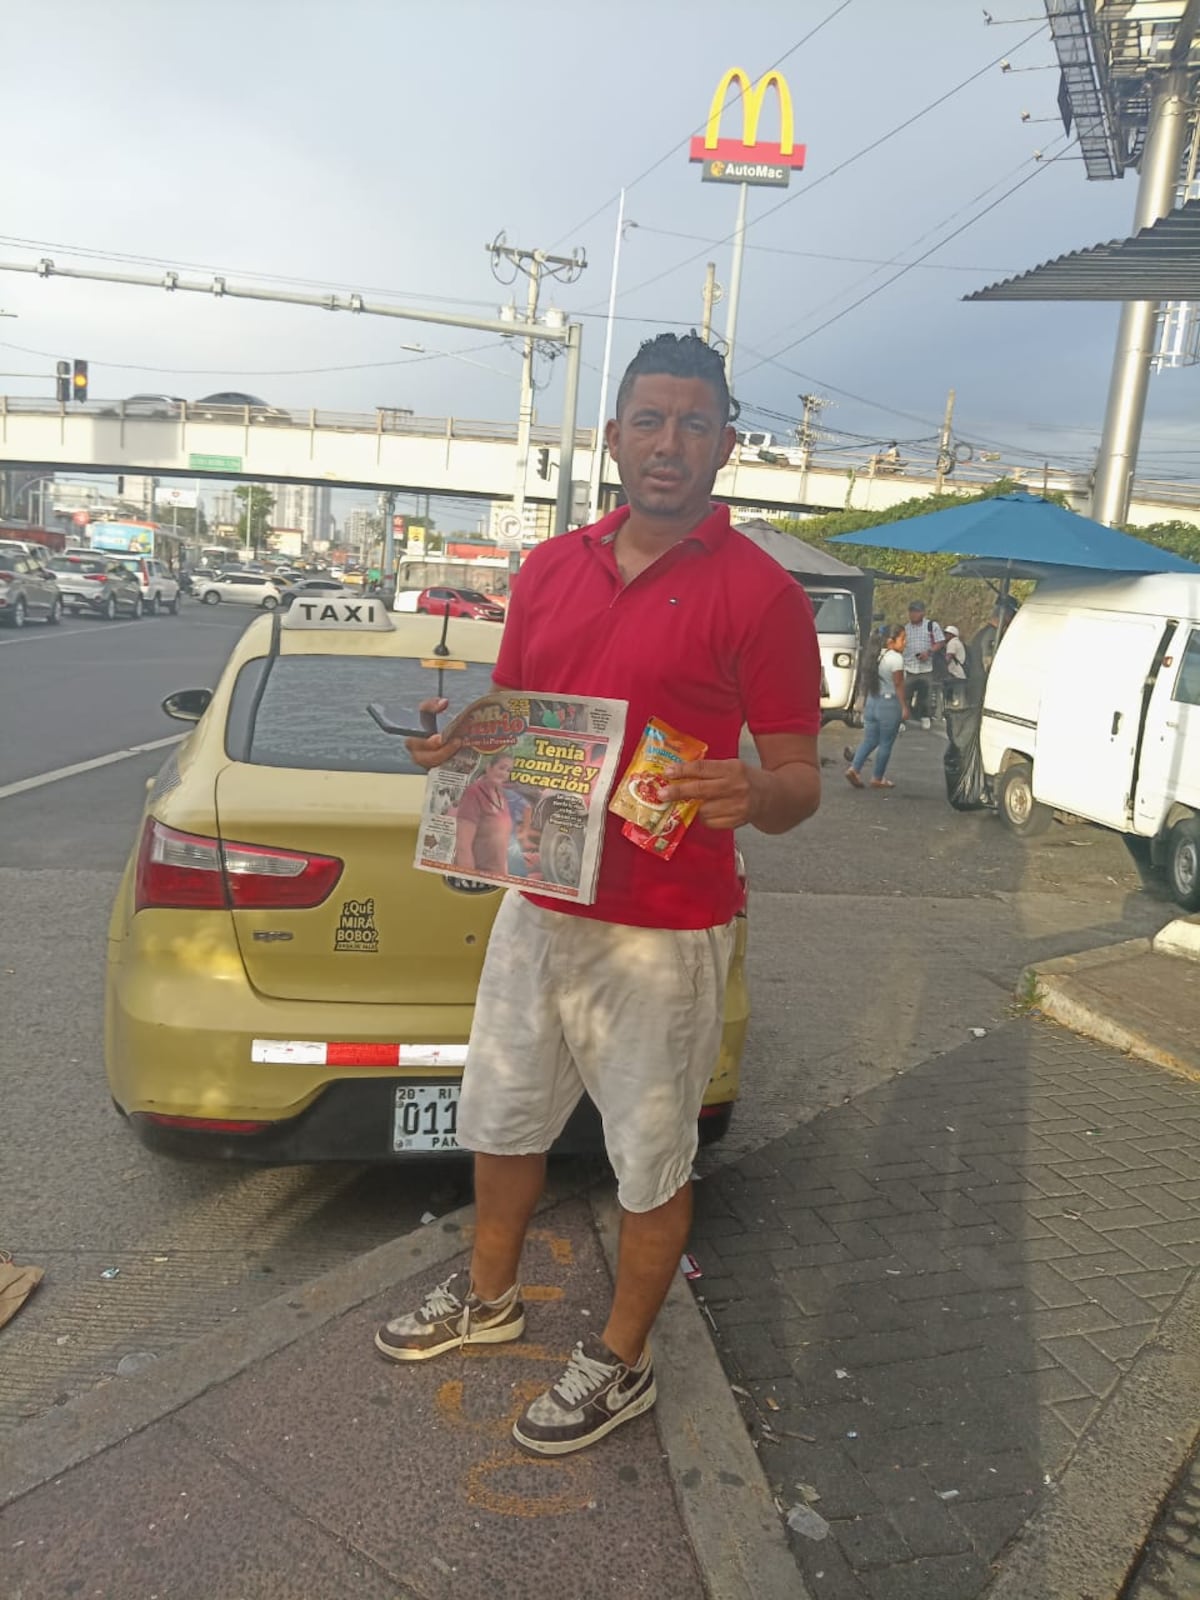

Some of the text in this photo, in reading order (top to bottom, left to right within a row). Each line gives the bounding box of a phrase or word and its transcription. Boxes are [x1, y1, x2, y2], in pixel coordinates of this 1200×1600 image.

[725, 163, 783, 179] AutoMac
[299, 603, 375, 623] TAXI
[535, 739, 585, 761] Tenía
[513, 757, 598, 781] nombre y
[510, 770, 591, 794] vocación
[337, 929, 378, 943] BOBO?
